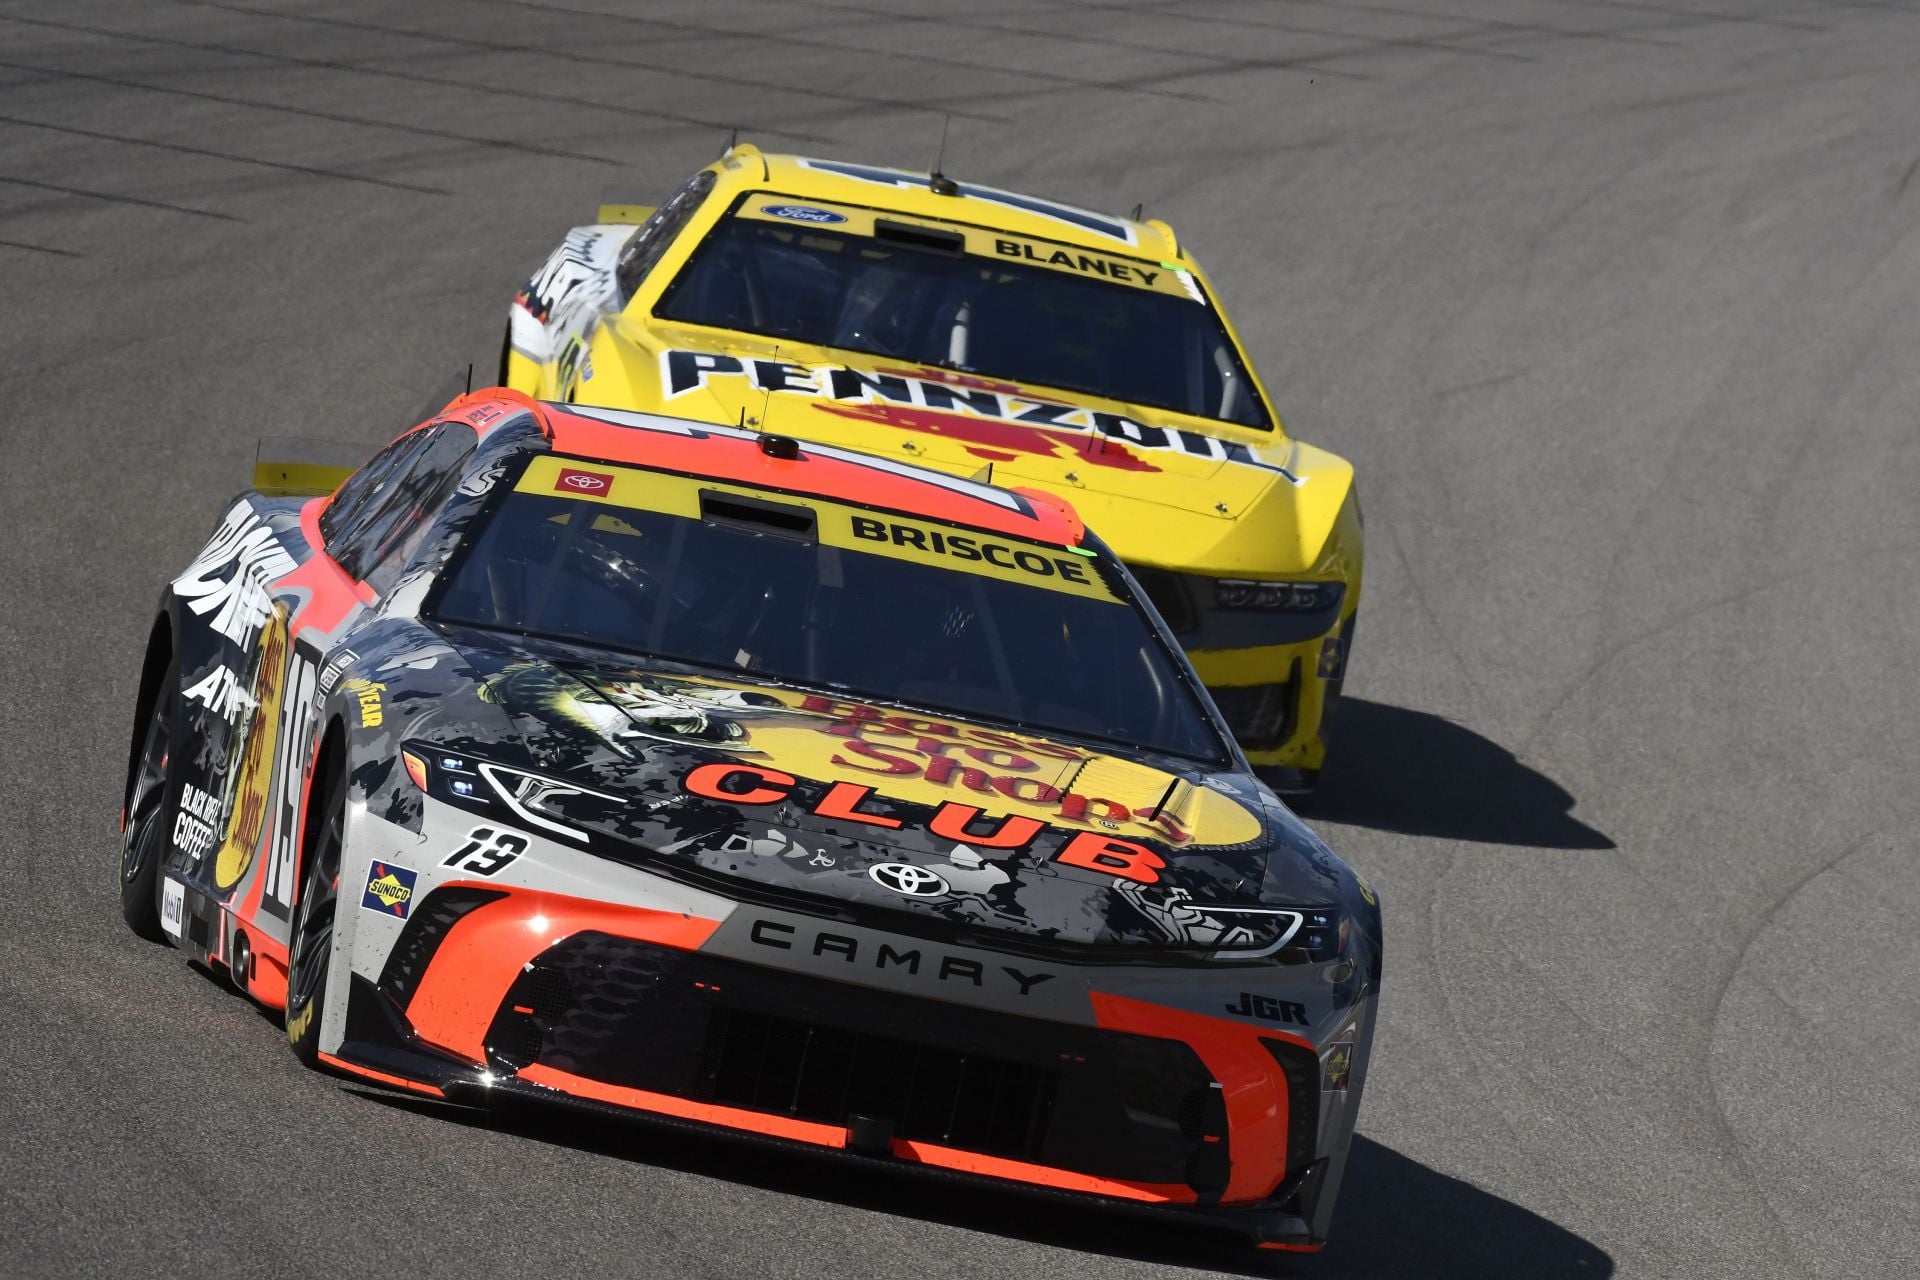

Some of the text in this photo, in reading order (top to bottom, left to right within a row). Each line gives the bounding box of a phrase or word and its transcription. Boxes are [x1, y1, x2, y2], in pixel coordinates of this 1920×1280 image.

[772, 205, 835, 222] Ford
[995, 239, 1159, 286] BLANEY
[665, 349, 1306, 487] PENNZOIL
[851, 515, 1092, 585] BRISCOE
[800, 694, 1088, 760] Bass
[826, 717, 1040, 771] Pro
[180, 782, 208, 818] BLACK
[684, 762, 1168, 885] CLUB
[173, 811, 212, 860] COFFEE
[370, 880, 410, 902] SUNOCO
[750, 919, 1056, 995] CAMRY
[1225, 992, 1310, 1027] JGR
